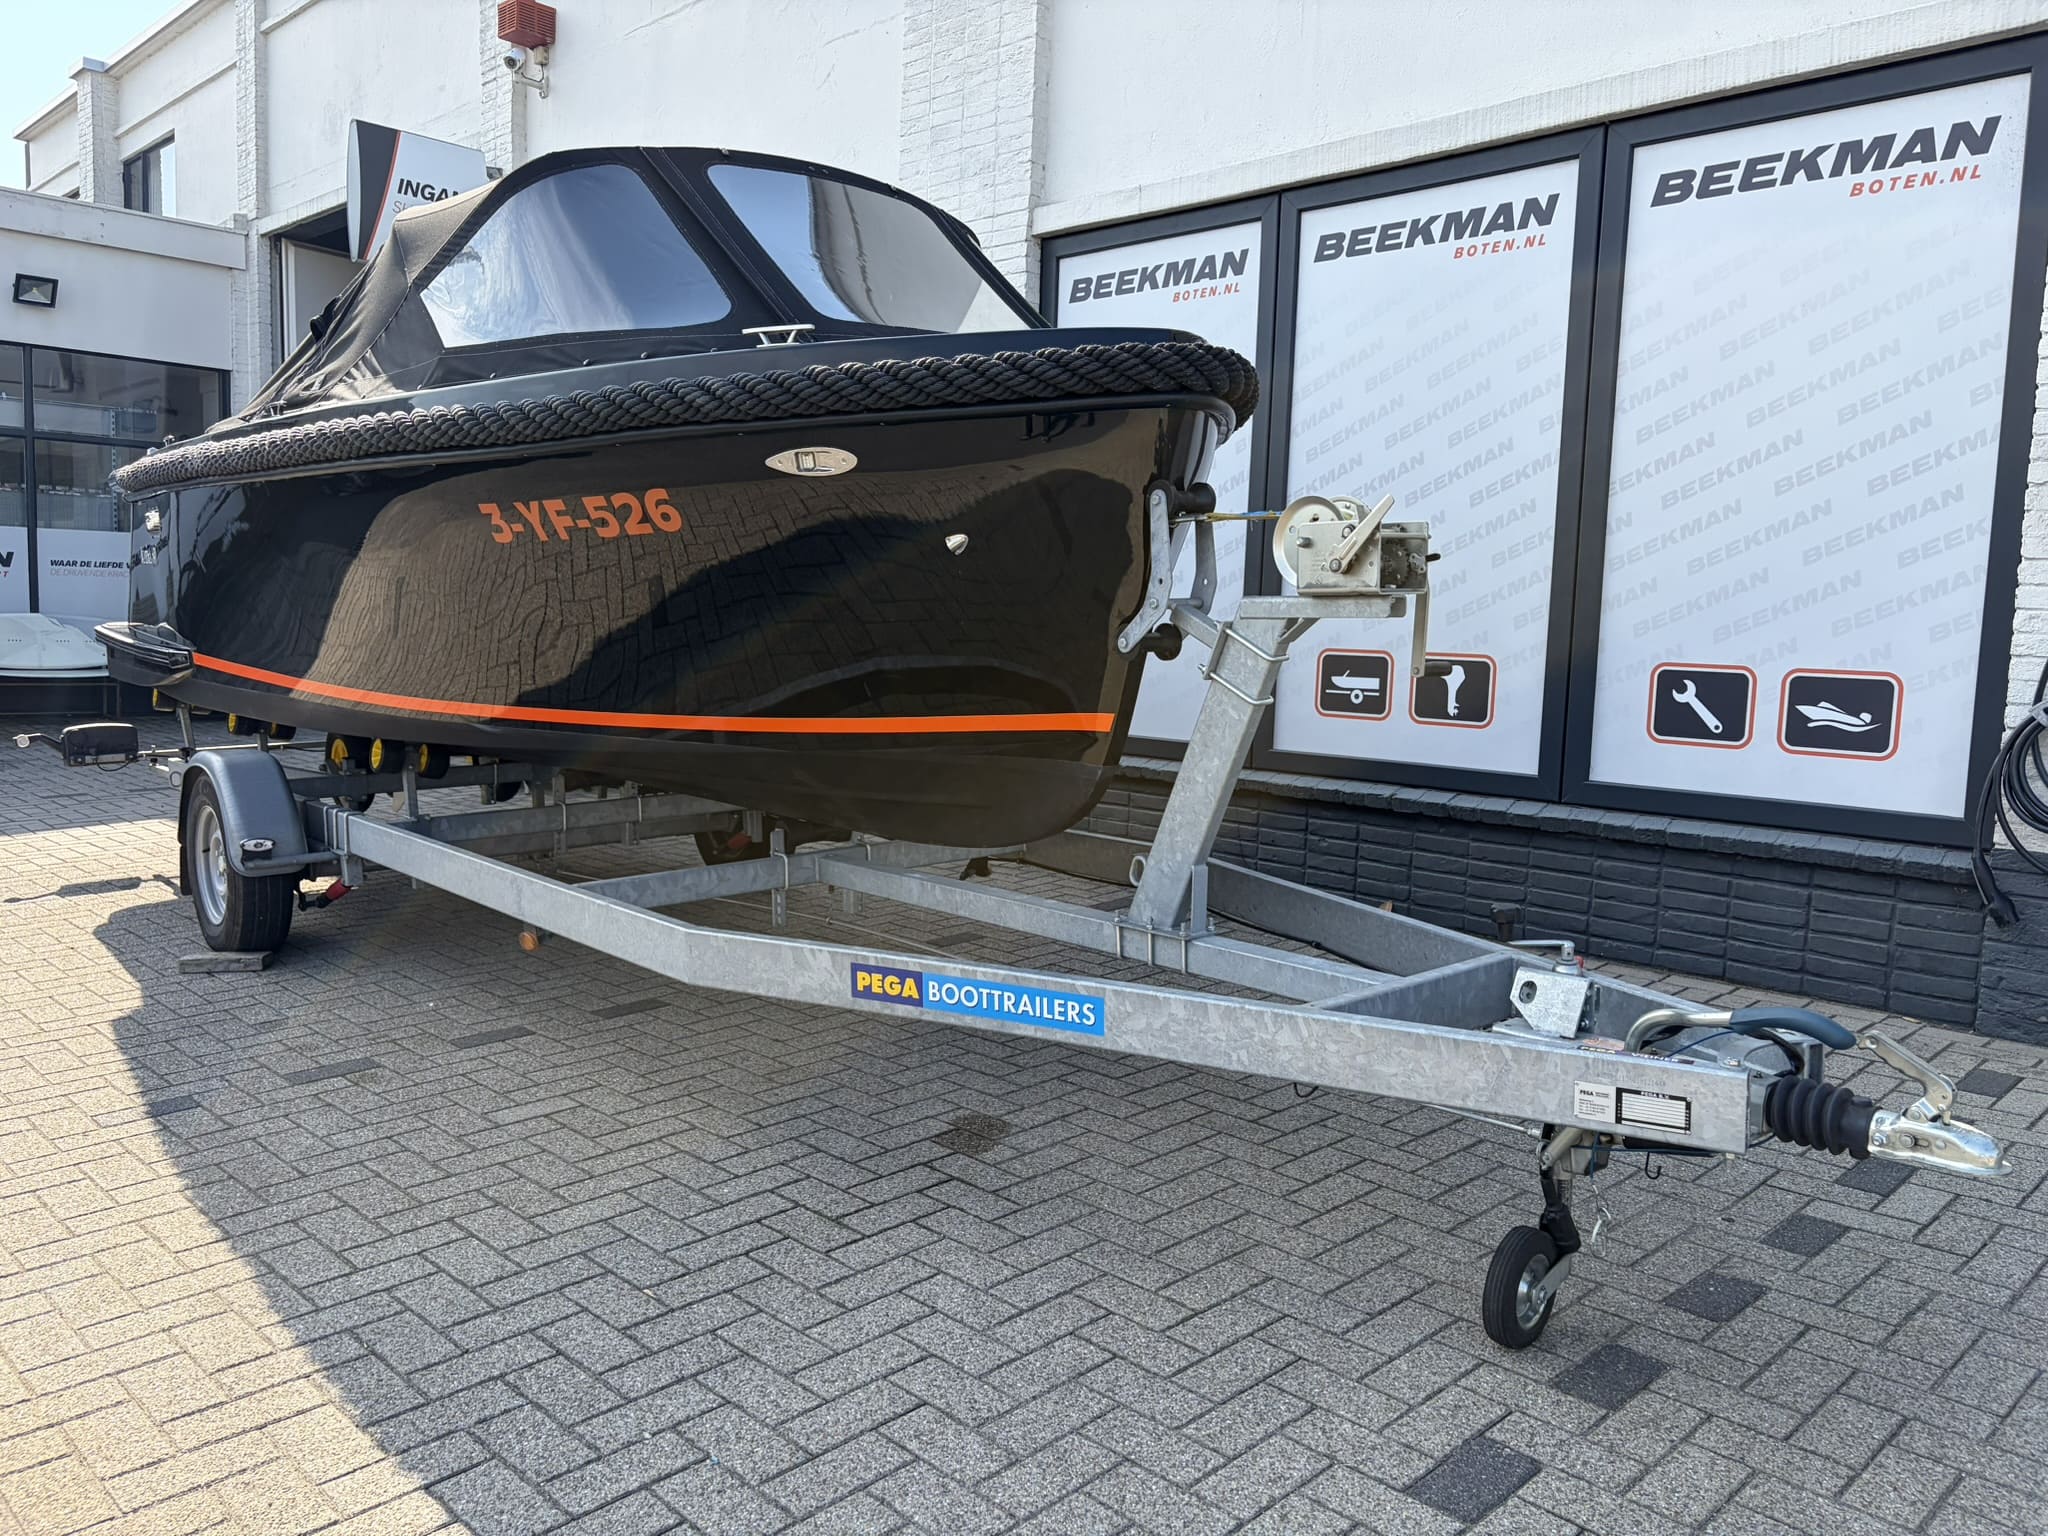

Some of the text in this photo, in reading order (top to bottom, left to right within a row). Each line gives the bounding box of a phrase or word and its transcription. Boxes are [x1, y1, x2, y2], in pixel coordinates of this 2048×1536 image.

[397, 178, 459, 202] INGA
[1650, 115, 2002, 208] BEEKMAN
[1849, 165, 1981, 198] BOTEN.NL
[1313, 193, 1560, 263] BEEKMAN
[1453, 234, 1546, 259] BOTEN.NL
[1069, 248, 1249, 304] BEEKMAN
[1172, 282, 1240, 303] BOTEN.NL
[1719, 267, 1870, 361] BEEKMAN
[1807, 257, 1971, 356] BEEKMAN
[1364, 317, 1469, 394] BEEKMAN
[1426, 312, 1539, 391] BEEKMAN
[1746, 337, 1902, 429] BEEKMAN
[1836, 331, 2003, 427] BEEKMAN
[1305, 393, 1404, 464] BEEKMAN
[1384, 376, 1492, 451] BEEKMAN
[1448, 373, 1561, 449] BEEKMAN
[1636, 360, 1776, 446] BEEKMAN
[1404, 436, 1515, 508] BEEKMAN
[1661, 429, 1803, 511] BEEKMAN
[1774, 410, 1932, 497] BEEKMAN
[478, 488, 682, 544] 3-YF-526
[1608, 498, 1742, 574] BEEKMAN
[1687, 498, 1832, 576] BEEKMAN
[1802, 483, 1964, 566] BEEKMAN
[50, 559, 78, 568] WAAR
[80, 560, 92, 568] DE
[93, 560, 124, 569] LIEFDE
[1632, 567, 1769, 638] BEEKMAN
[1713, 569, 1862, 645] BEEKMAN
[856, 971, 1096, 1026] PEGA BOOTTRAILERS
